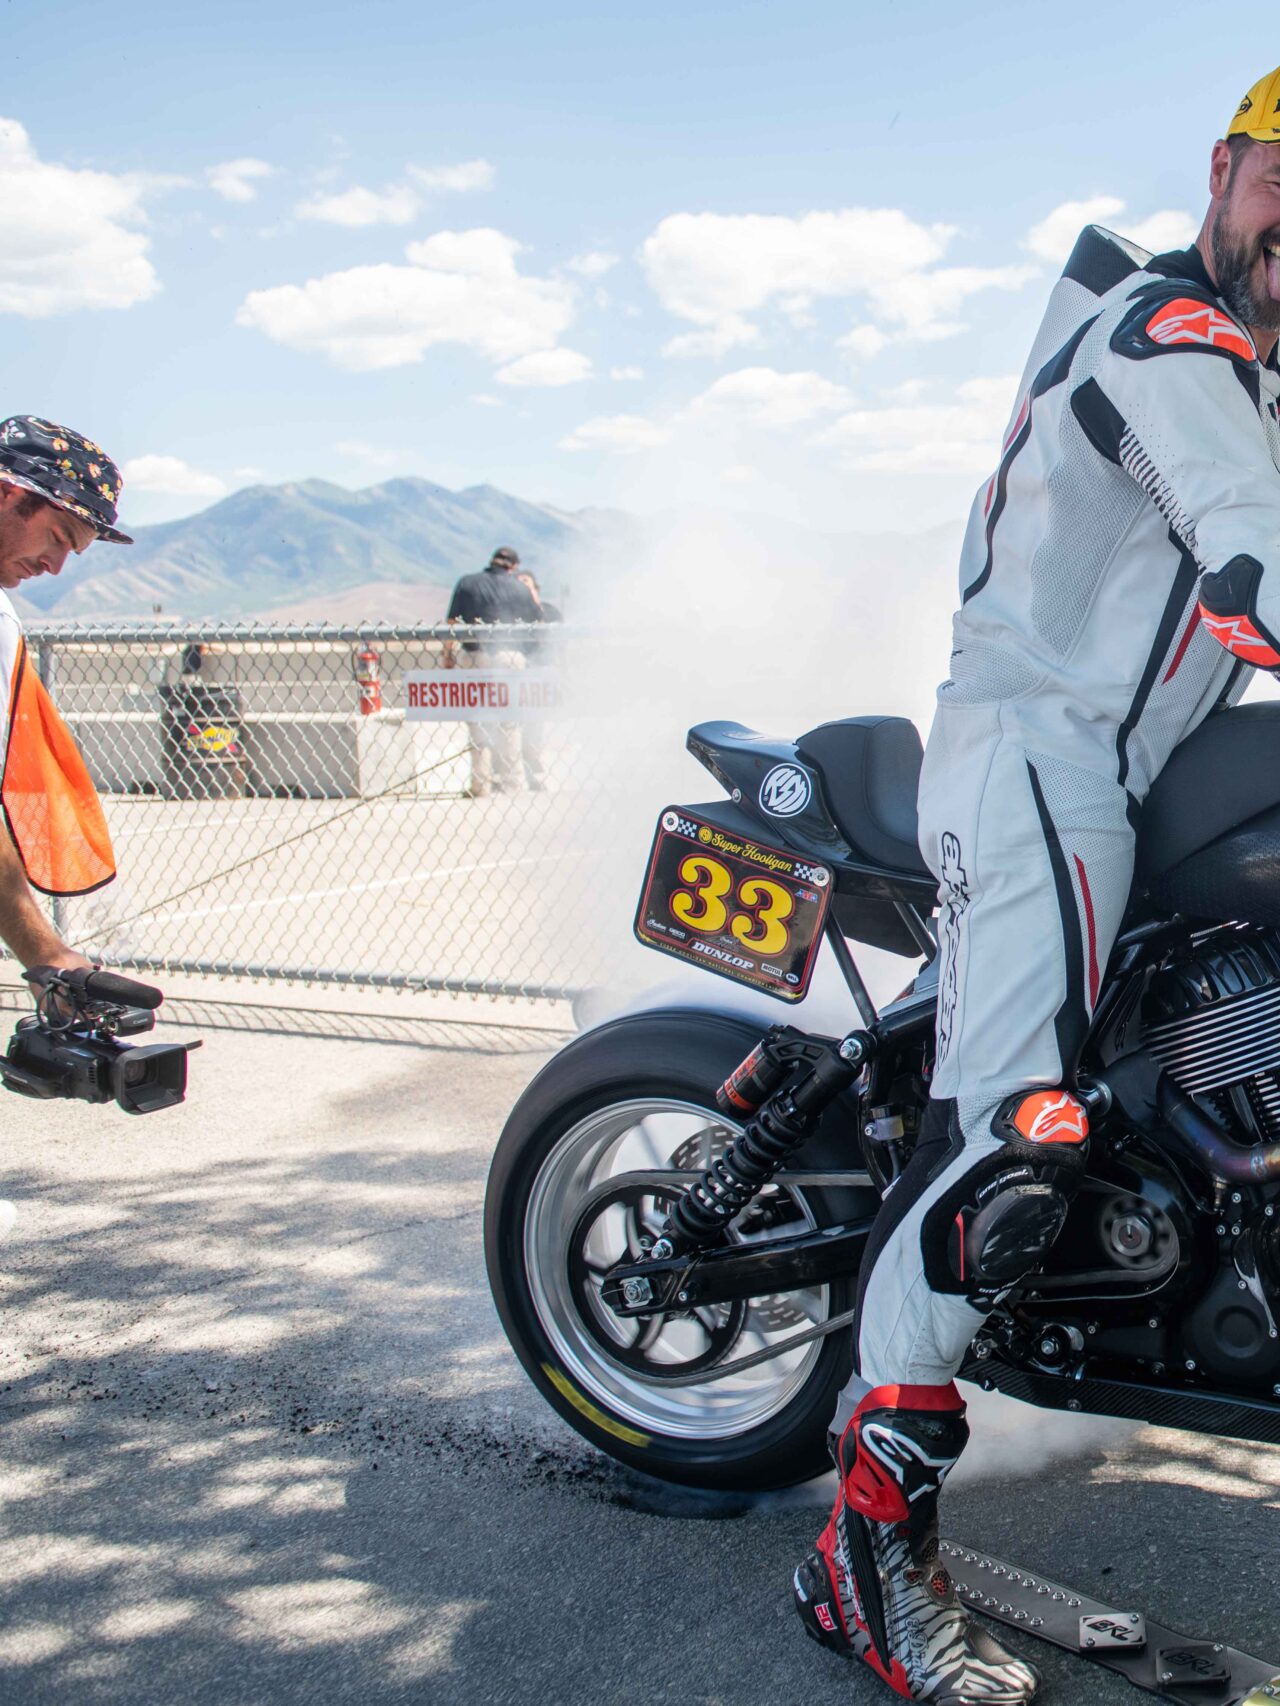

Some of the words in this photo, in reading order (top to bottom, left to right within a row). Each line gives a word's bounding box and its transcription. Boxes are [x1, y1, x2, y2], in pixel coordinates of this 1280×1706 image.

[408, 682, 509, 708] RESTRICTED
[711, 833, 743, 853] Super
[742, 844, 793, 872] Hooligan
[669, 854, 796, 957] 33
[692, 942, 754, 969] DUNLOP
